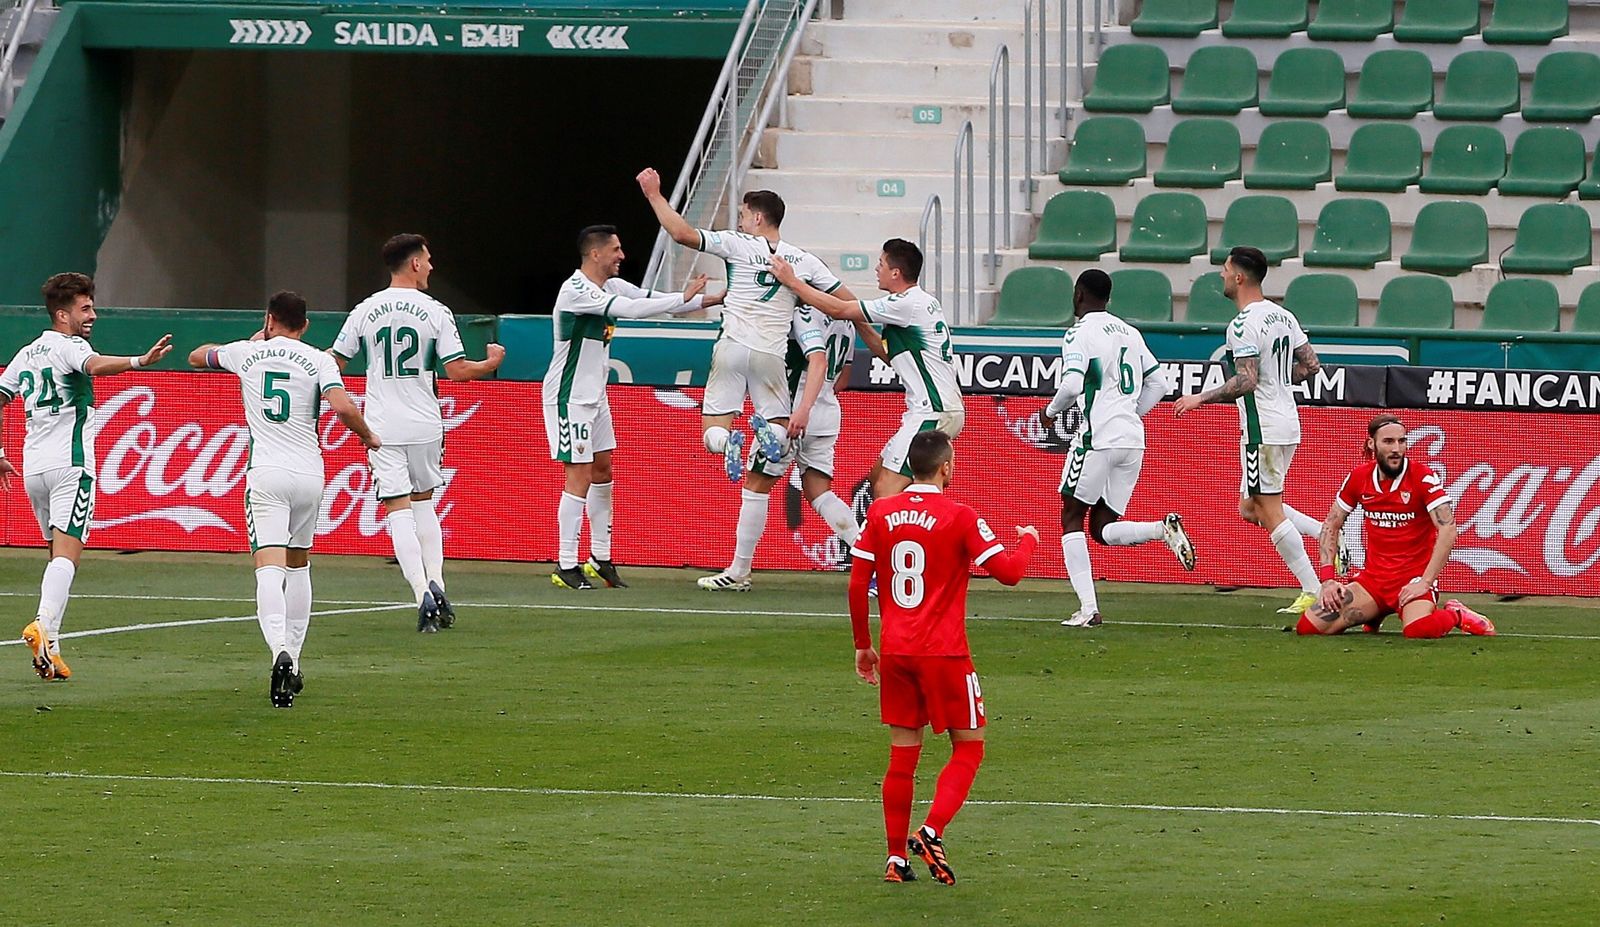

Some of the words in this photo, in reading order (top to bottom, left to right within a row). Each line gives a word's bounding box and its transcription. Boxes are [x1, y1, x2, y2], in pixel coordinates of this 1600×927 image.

[334, 21, 438, 47] SALIDA
[461, 23, 525, 48] EXIT
[919, 110, 935, 121] 05
[882, 183, 898, 193] 04
[847, 257, 862, 268] 03
[754, 270, 782, 302] 9
[368, 302, 393, 323] DANI
[395, 301, 429, 321] CALVO
[241, 348, 286, 373] GONZALO
[288, 350, 319, 377] VERDÚ
[374, 326, 420, 379] 12
[1272, 335, 1291, 387] 11
[869, 354, 1063, 389] #NCAM
[1118, 346, 1135, 396] 6
[19, 366, 64, 416] 24
[261, 371, 290, 424] 5
[572, 423, 588, 440] 16
[884, 510, 937, 532] JORDÁN
[1379, 520, 1397, 528] BET
[891, 540, 925, 609] 8
[971, 671, 982, 698] 8
